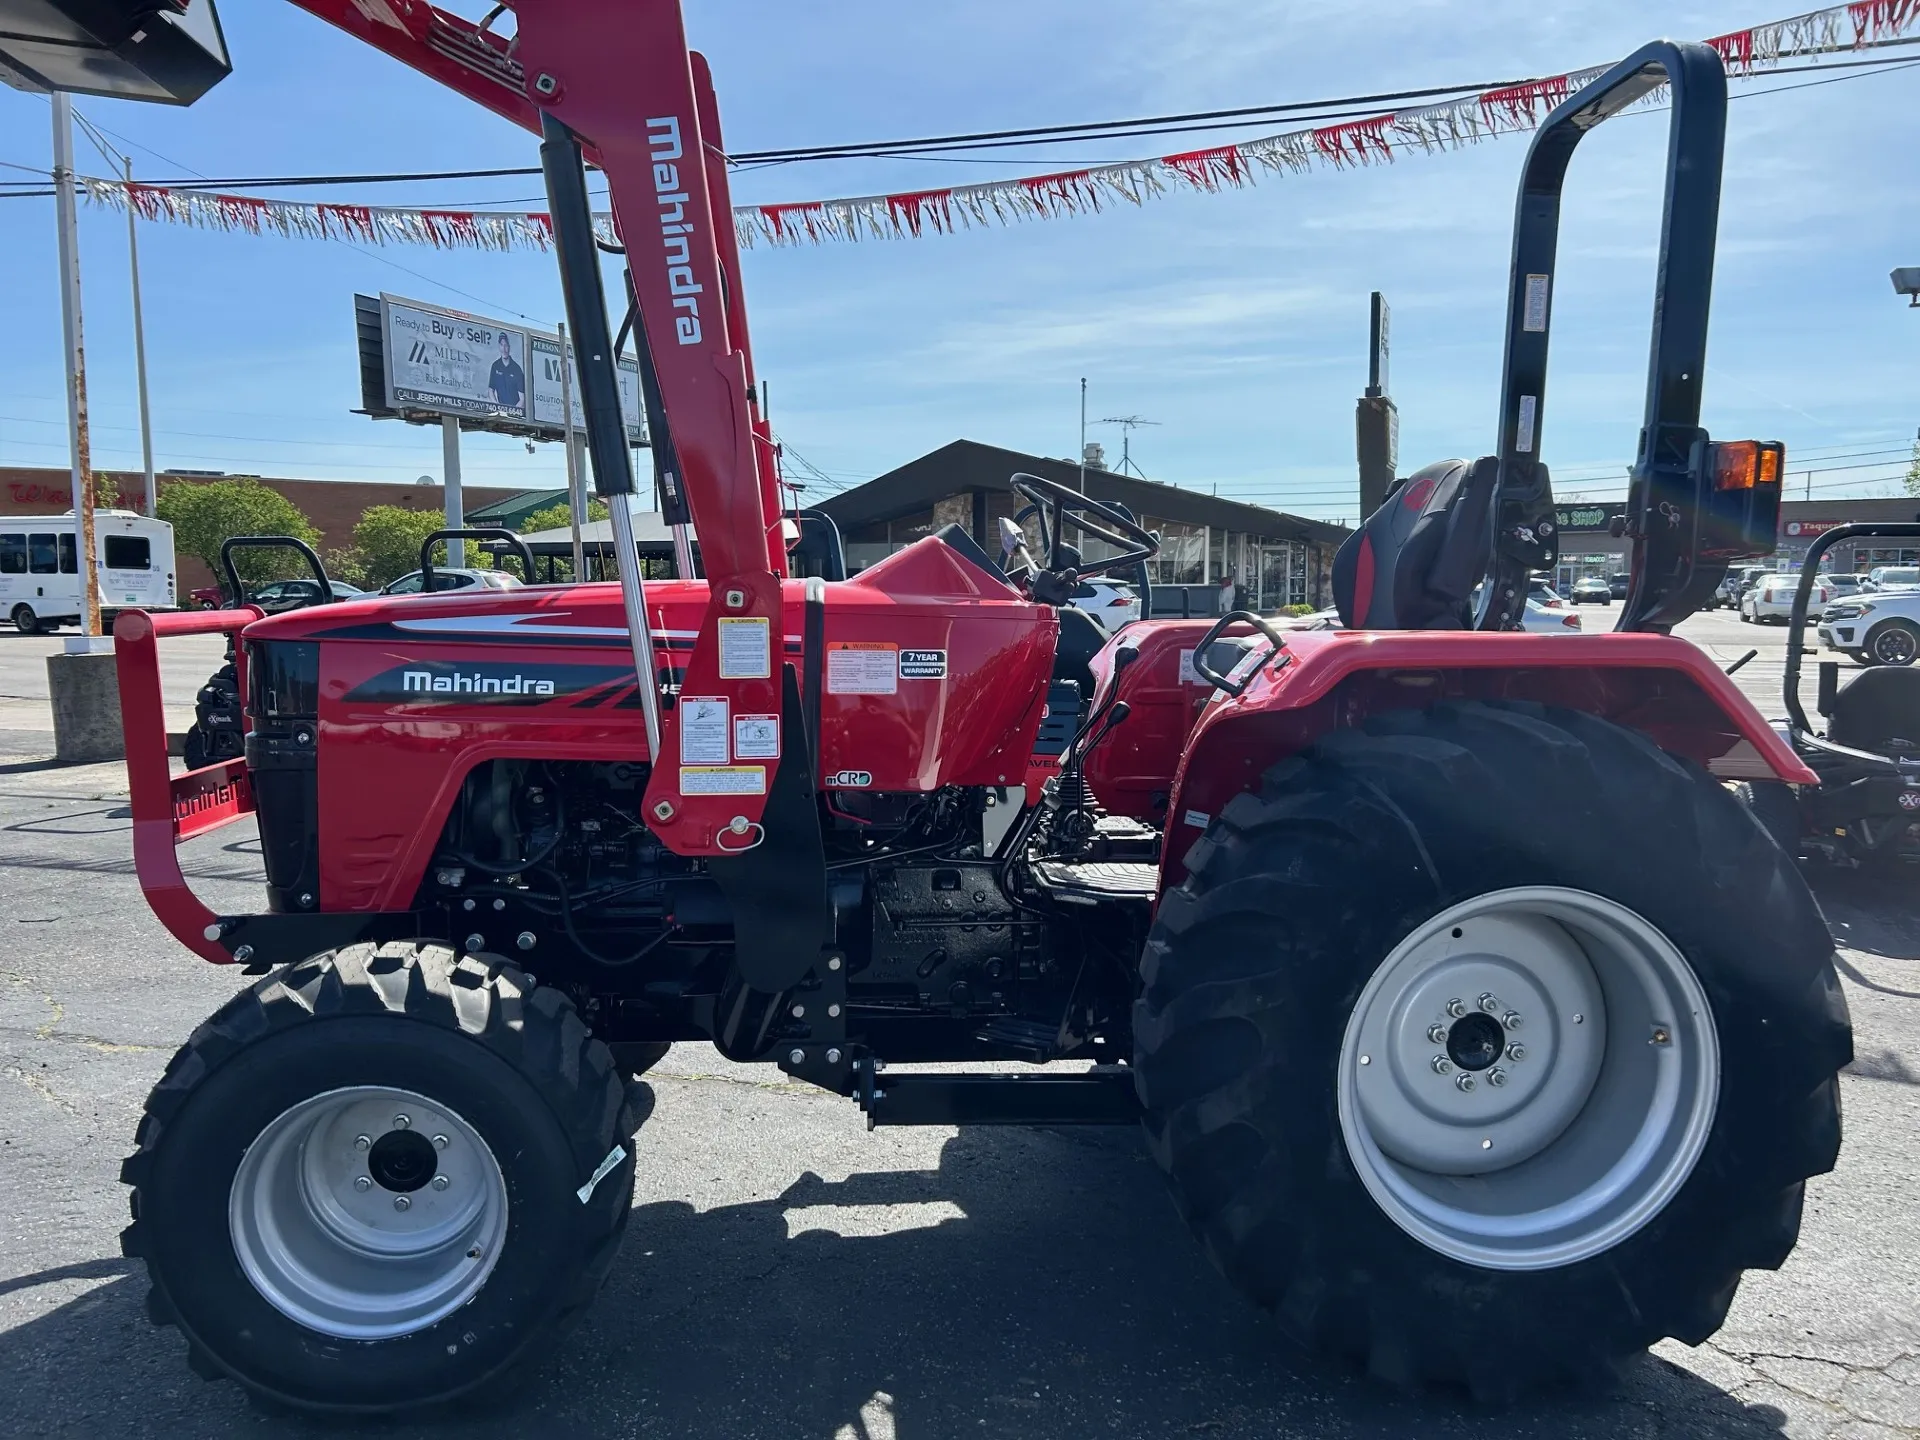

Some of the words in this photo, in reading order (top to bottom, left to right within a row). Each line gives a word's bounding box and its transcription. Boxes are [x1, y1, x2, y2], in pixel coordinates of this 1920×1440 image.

[646, 116, 703, 345] Mahindra
[395, 316, 420, 332] Ready
[421, 322, 430, 332] to
[432, 320, 454, 339] Buy
[457, 331, 465, 339] or
[466, 328, 492, 345] Sell?
[435, 346, 470, 363] MILLS
[425, 373, 439, 384] Rise
[441, 375, 462, 388] Realty
[462, 380, 473, 389] Co.
[398, 390, 417, 400] CALL
[416, 392, 443, 404] JEREMY
[443, 396, 462, 407] MILLS
[1571, 509, 1605, 526] SHOP
[908, 652, 915, 662] 7
[403, 671, 555, 695] Mahindra
